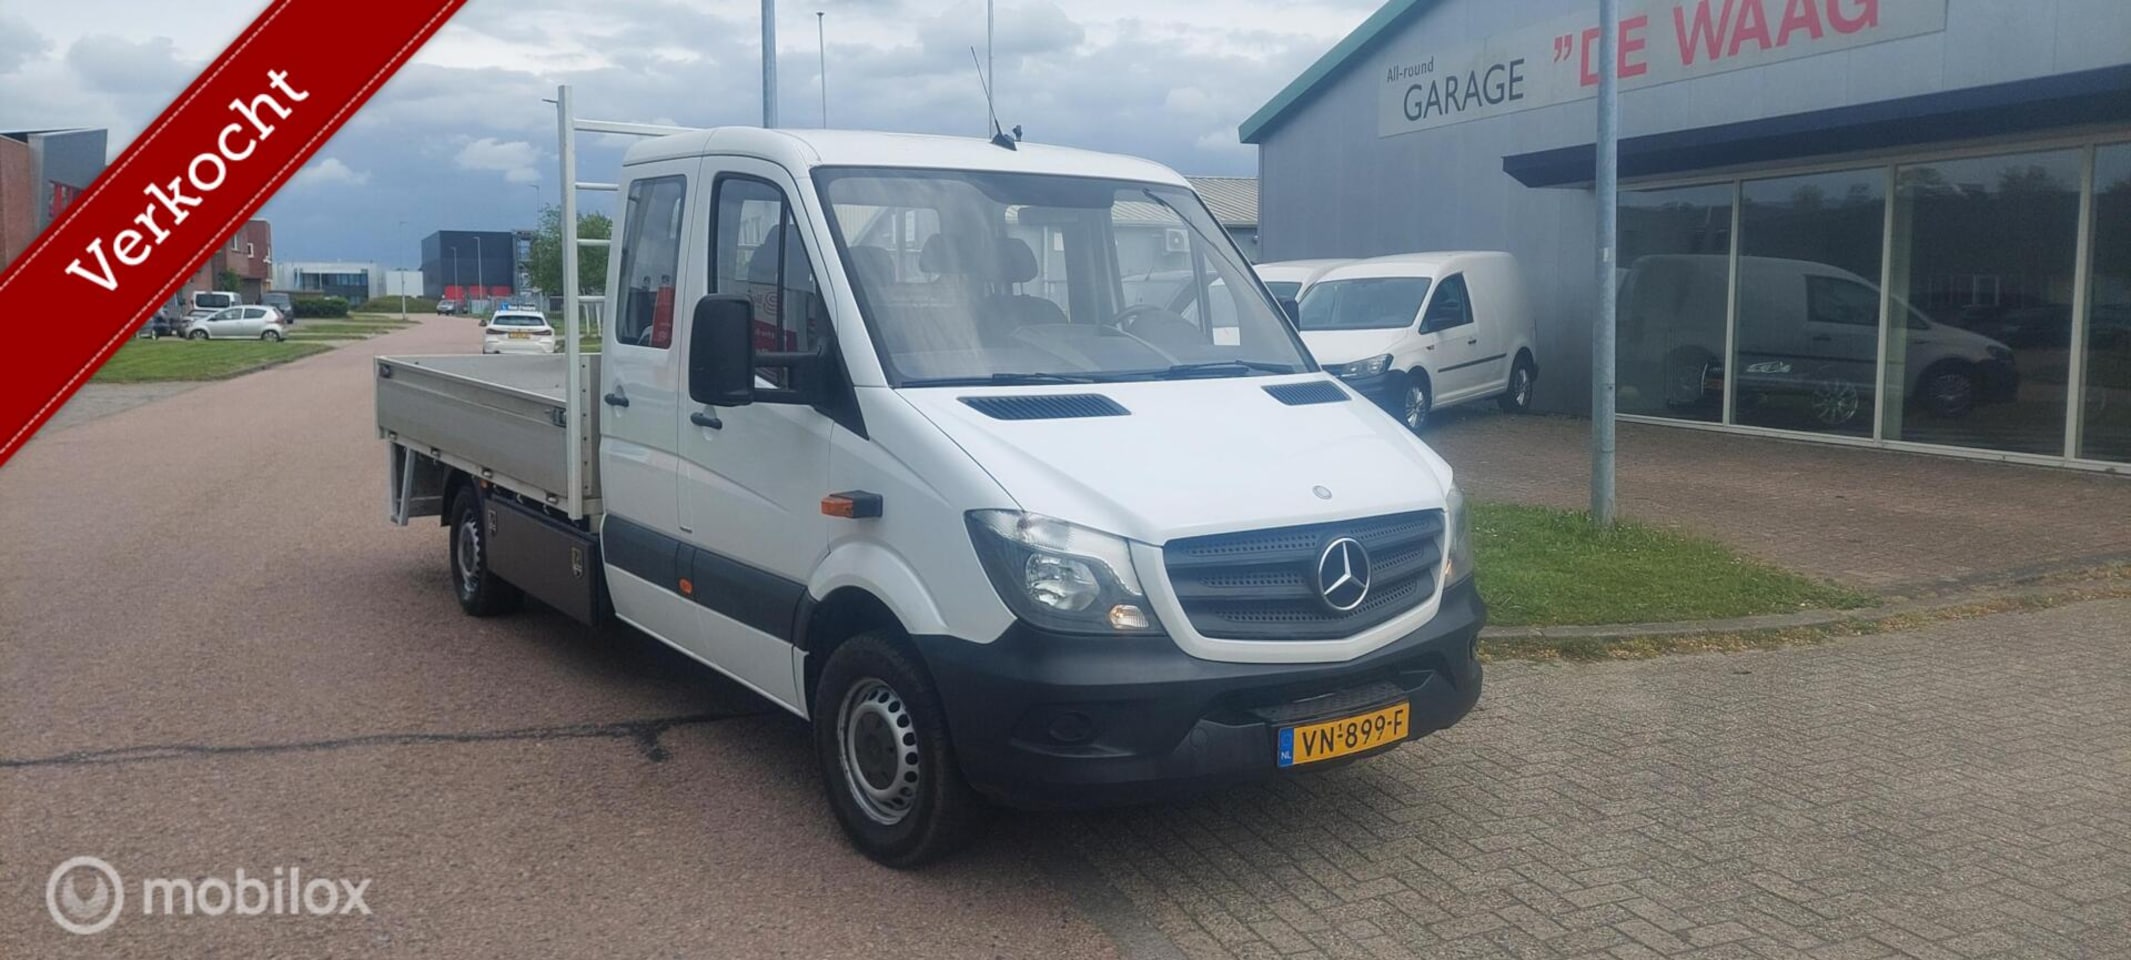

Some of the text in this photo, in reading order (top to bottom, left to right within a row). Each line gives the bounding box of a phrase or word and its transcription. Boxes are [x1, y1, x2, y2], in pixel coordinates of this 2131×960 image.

[1387, 55, 1434, 82] All-round
[1403, 58, 1525, 121] GARAGE
[1302, 709, 1404, 757] VN-899-F
[1281, 751, 1292, 761] NL
